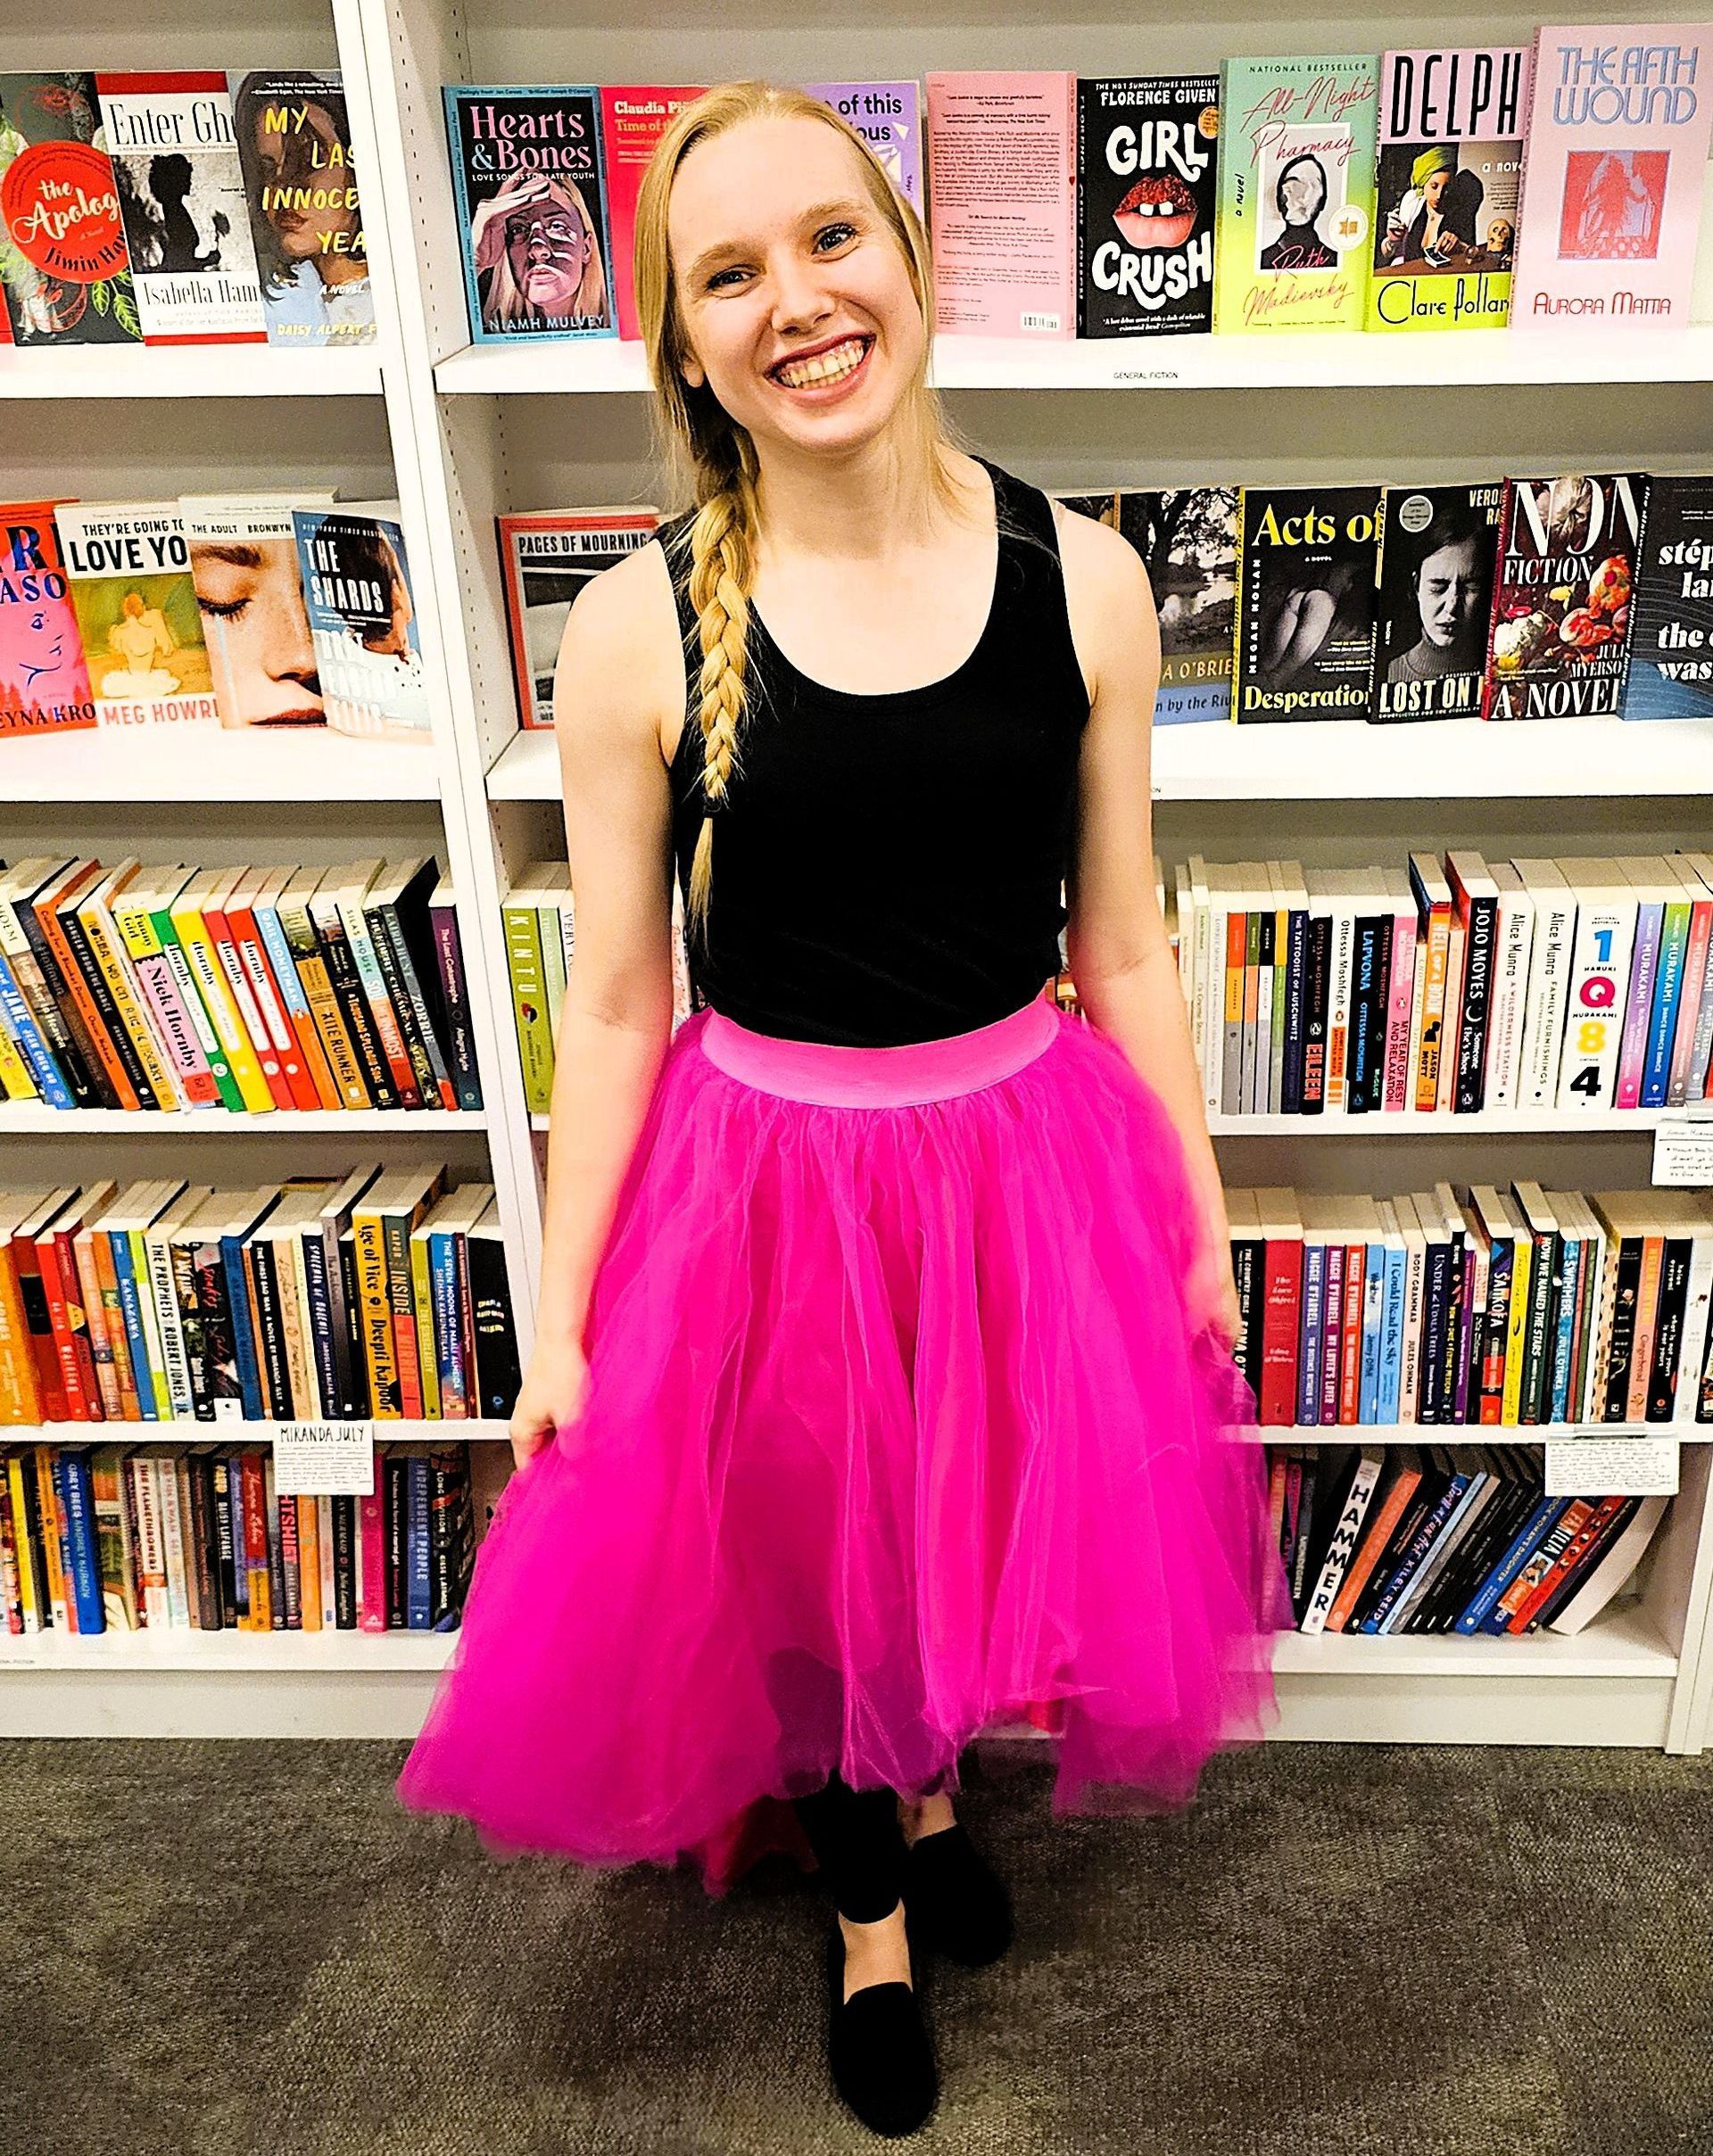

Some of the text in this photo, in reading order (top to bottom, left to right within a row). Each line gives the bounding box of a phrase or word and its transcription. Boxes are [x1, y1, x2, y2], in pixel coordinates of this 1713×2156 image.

[1249, 62, 1368, 73] NATIONAL BESTSELLER
[1556, 45, 1618, 85] THE
[614, 100, 666, 114] Claudia
[838, 92, 903, 115] of this
[1100, 88, 1216, 106] FLORENCE GIVEN
[1240, 76, 1378, 134] All-Night
[1552, 85, 1698, 125] WOUND
[109, 102, 184, 146] Enter
[264, 105, 309, 135] MY
[469, 105, 585, 139] Hearts
[614, 119, 661, 132] Time of
[496, 139, 592, 170] Bones
[1105, 120, 1209, 183] GIRL
[1250, 120, 1361, 168] Pharmacy
[39, 178, 74, 202] the
[471, 173, 494, 181] LOVE
[43, 246, 99, 273] Jimin
[1091, 230, 1213, 310] CRUSH
[1271, 244, 1330, 282] Ruth
[143, 281, 213, 307] Isabella
[1377, 279, 1447, 325] Clare
[1533, 291, 1672, 316] AURORA MATTIA
[488, 314, 606, 331] NIAMH MULVEY
[1113, 371, 1179, 380] GENERAL FICTION
[82, 520, 169, 537] THEY'RE GOING
[191, 524, 208, 534] THE
[211, 524, 238, 533] ADULT
[247, 523, 292, 533] BRONWYN
[517, 533, 648, 554] PAGES OF MOURNING
[1251, 503, 1336, 546] Acts
[69, 537, 145, 573] LOVE
[303, 538, 341, 574] THE
[1502, 557, 1593, 585] FICTION
[310, 575, 385, 613] SHARDS
[1249, 558, 1262, 673] MEGAN NOLAN
[1658, 622, 1704, 649] the
[103, 705, 145, 726] MEG
[1167, 697, 1207, 714] by the
[1378, 677, 1470, 714] LOST ON
[1491, 685, 1514, 719] A
[123, 917, 139, 939] Girl
[135, 913, 153, 948] Funny
[345, 908, 373, 973] SILAS HOUSE
[1506, 913, 1527, 977] Alice Munro
[1544, 912, 1566, 976] Alice Munro
[1593, 929, 1613, 962] 1
[167, 943, 191, 987] Hornby
[192, 941, 215, 985] Hornby
[220, 940, 246, 985] Hornby
[244, 940, 267, 984] Hornby
[261, 912, 300, 1004] GAIL HONEYMAN
[438, 926, 466, 1004] The Last Catastrophe
[508, 913, 538, 995] KINTU
[1291, 929, 1302, 978] TATTOOIST
[1333, 919, 1351, 1006] Ottessa Moshfegh
[1358, 929, 1374, 991] LAPVONA
[1469, 905, 1491, 999] JOJO MOYES
[1660, 940, 1677, 1003] MURAKAMI
[1579, 976, 1616, 1008] Q
[1634, 942, 1653, 1004] MURAKAMI
[3, 988, 29, 1024] JANE
[147, 966, 198, 1070] Nick Hornby
[410, 995, 435, 1044] ZORRIE
[1288, 990, 1299, 1041] AUSCHWITZ
[450, 1025, 472, 1073] Allegra Hyde
[1469, 1030, 1482, 1070] Someone
[1538, 980, 1558, 1086] FAMILY FURNISHINGS
[1576, 1021, 1606, 1053] 8
[330, 1037, 352, 1084] RUNNER
[1303, 1043, 1323, 1101] EILEEN
[1385, 1020, 1400, 1103] AND RELAXATION
[1394, 1020, 1408, 1103] MY YEAR OF REST
[1419, 1050, 1428, 1077] MOTT
[1428, 1048, 1438, 1080] JASON
[1459, 1050, 1469, 1076] Shoes
[1569, 1066, 1601, 1097] 4
[150, 1243, 182, 1365] THE PROPHETS ROBERT
[389, 1268, 410, 1315] INSIDE
[1388, 1268, 1401, 1300] Could
[1488, 1270, 1508, 1328] SANKOFA
[1529, 1235, 1552, 1357] HOW NAMED STARS
[120, 1276, 141, 1340] KANAZAWA
[356, 1221, 400, 1414] Age of Vice Deepti Kapoor
[1386, 1301, 1398, 1327] Read
[1404, 1252, 1421, 1394] BODY GRAMMAR JULES OHMAN
[1553, 1259, 1576, 1391] SWIMMERS JULIE OTSUKA
[1383, 1346, 1395, 1367] Sky
[1386, 1328, 1396, 1346] the
[280, 1425, 364, 1442] MIRANDA JULY
[67, 1462, 81, 1518] GREY BEES
[412, 1463, 430, 1581] INDEPENDENT PEOPLE
[219, 1525, 232, 1560] LAFARGE
[1313, 1484, 1370, 1611] HAMMER
[1294, 1535, 1307, 1598] MONDEGREEN
[1496, 1544, 1526, 1582] DAUGHTER
[1371, 1557, 1415, 1622] KILEY REID
